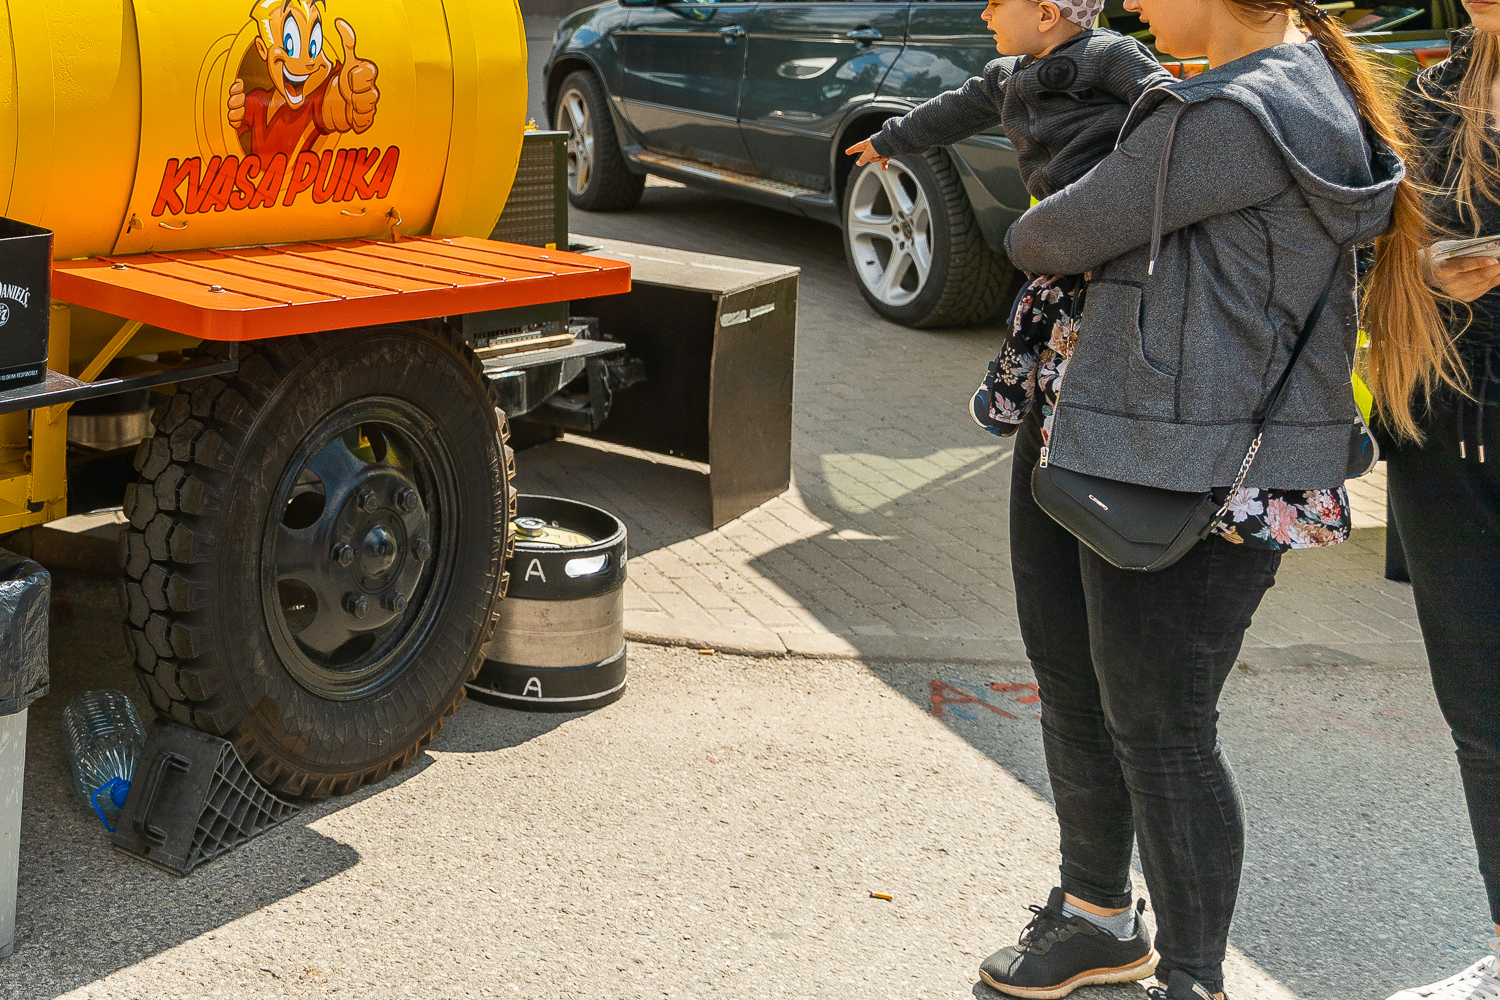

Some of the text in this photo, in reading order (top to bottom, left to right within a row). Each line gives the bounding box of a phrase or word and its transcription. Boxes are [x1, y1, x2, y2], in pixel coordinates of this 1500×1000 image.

[151, 145, 400, 217] KVASA PUIKA
[525, 558, 546, 582] A
[522, 677, 542, 698] A
